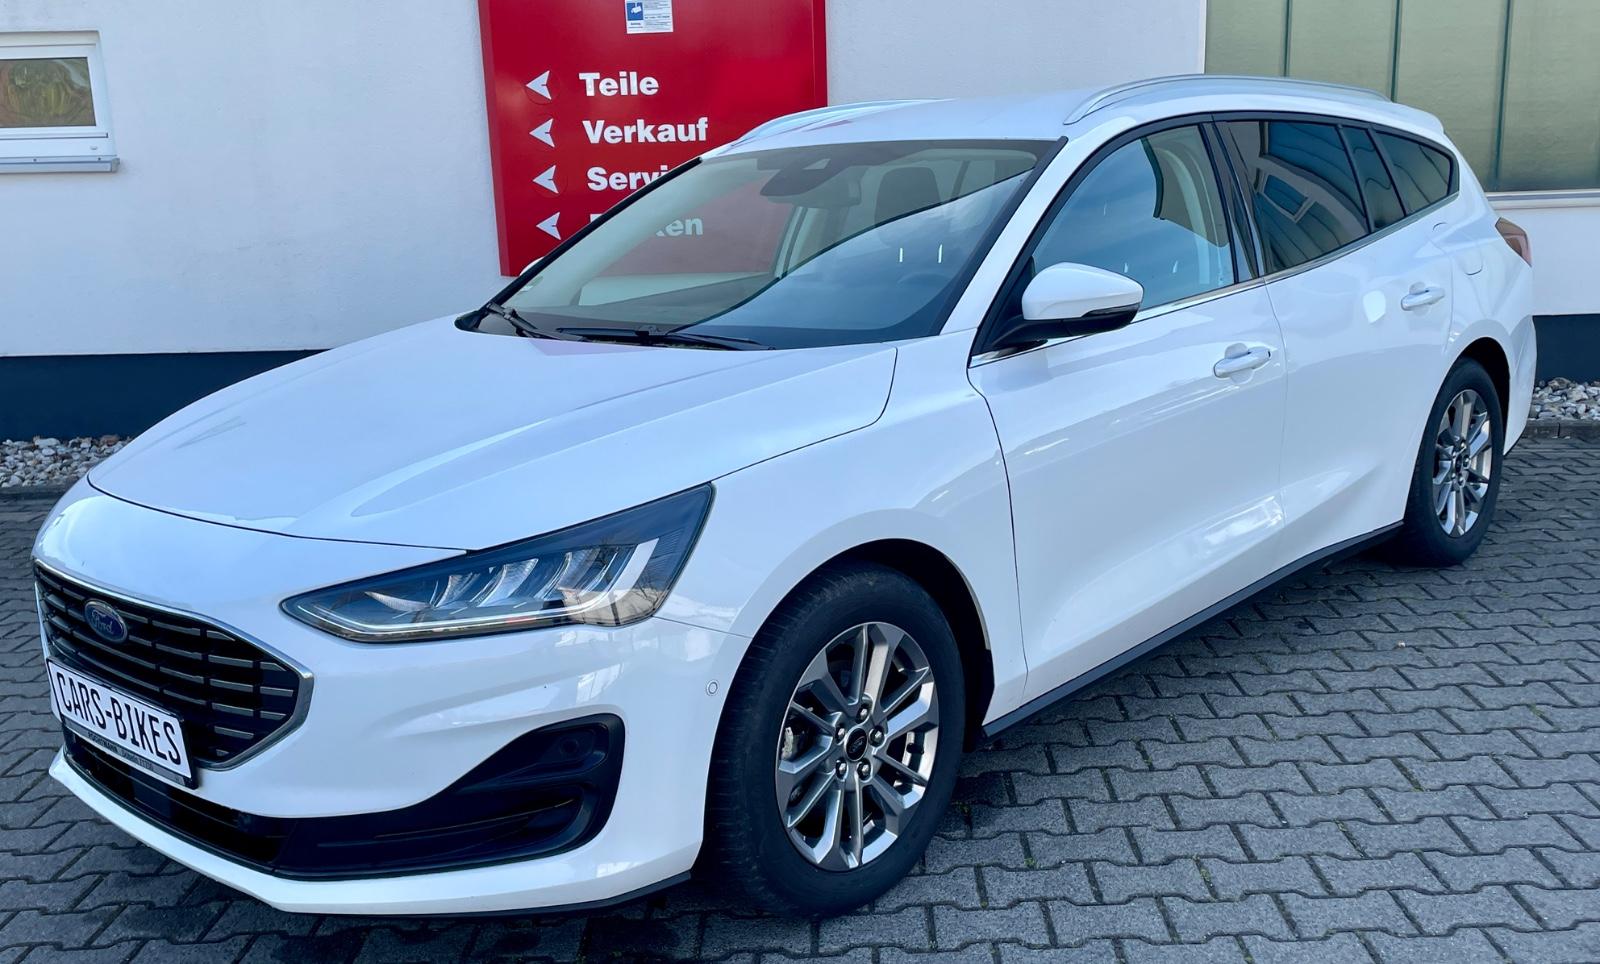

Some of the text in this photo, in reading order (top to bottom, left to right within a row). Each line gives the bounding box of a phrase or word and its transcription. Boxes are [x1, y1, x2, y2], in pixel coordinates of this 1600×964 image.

[579, 71, 659, 96] Teile
[582, 117, 708, 143] Verkauf
[587, 165, 668, 191] Serv
[56, 671, 181, 766] CARS-BIKES
